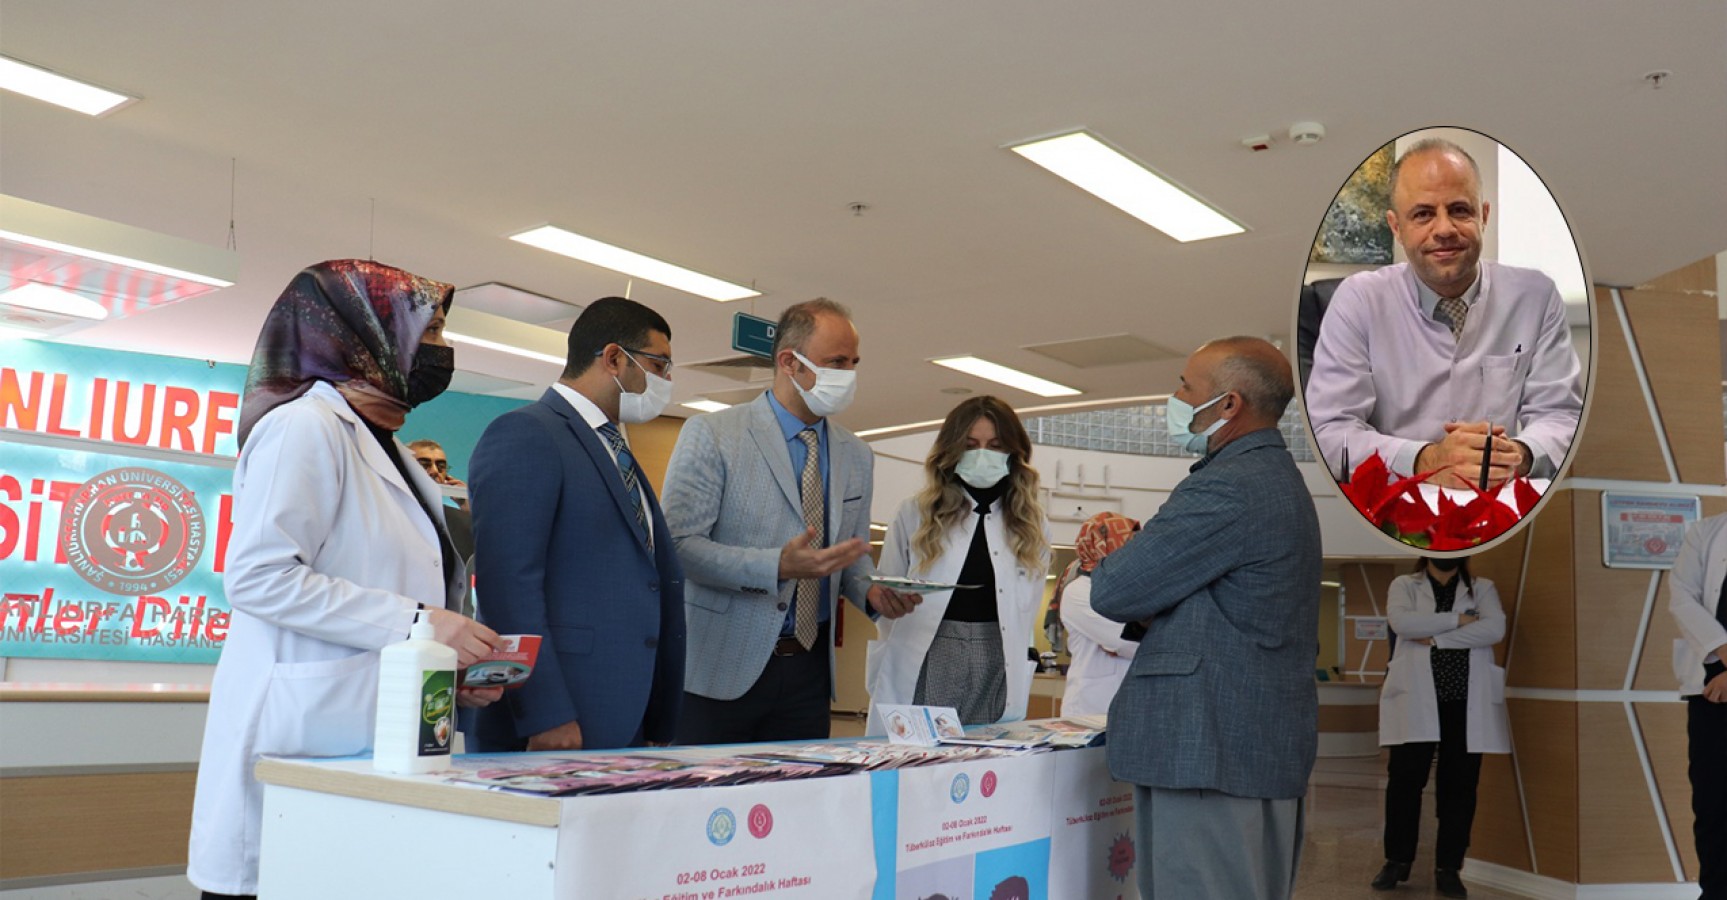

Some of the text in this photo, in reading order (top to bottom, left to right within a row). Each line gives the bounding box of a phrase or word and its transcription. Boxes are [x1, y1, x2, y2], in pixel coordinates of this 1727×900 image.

[0, 367, 240, 458] NLIURF
[120, 582, 148, 592] 1994
[677, 863, 766, 885] 02-08 Ocak 2022
[702, 891, 714, 900] ve
[718, 880, 775, 898] Farkındalık
[778, 876, 812, 889] Haftası
